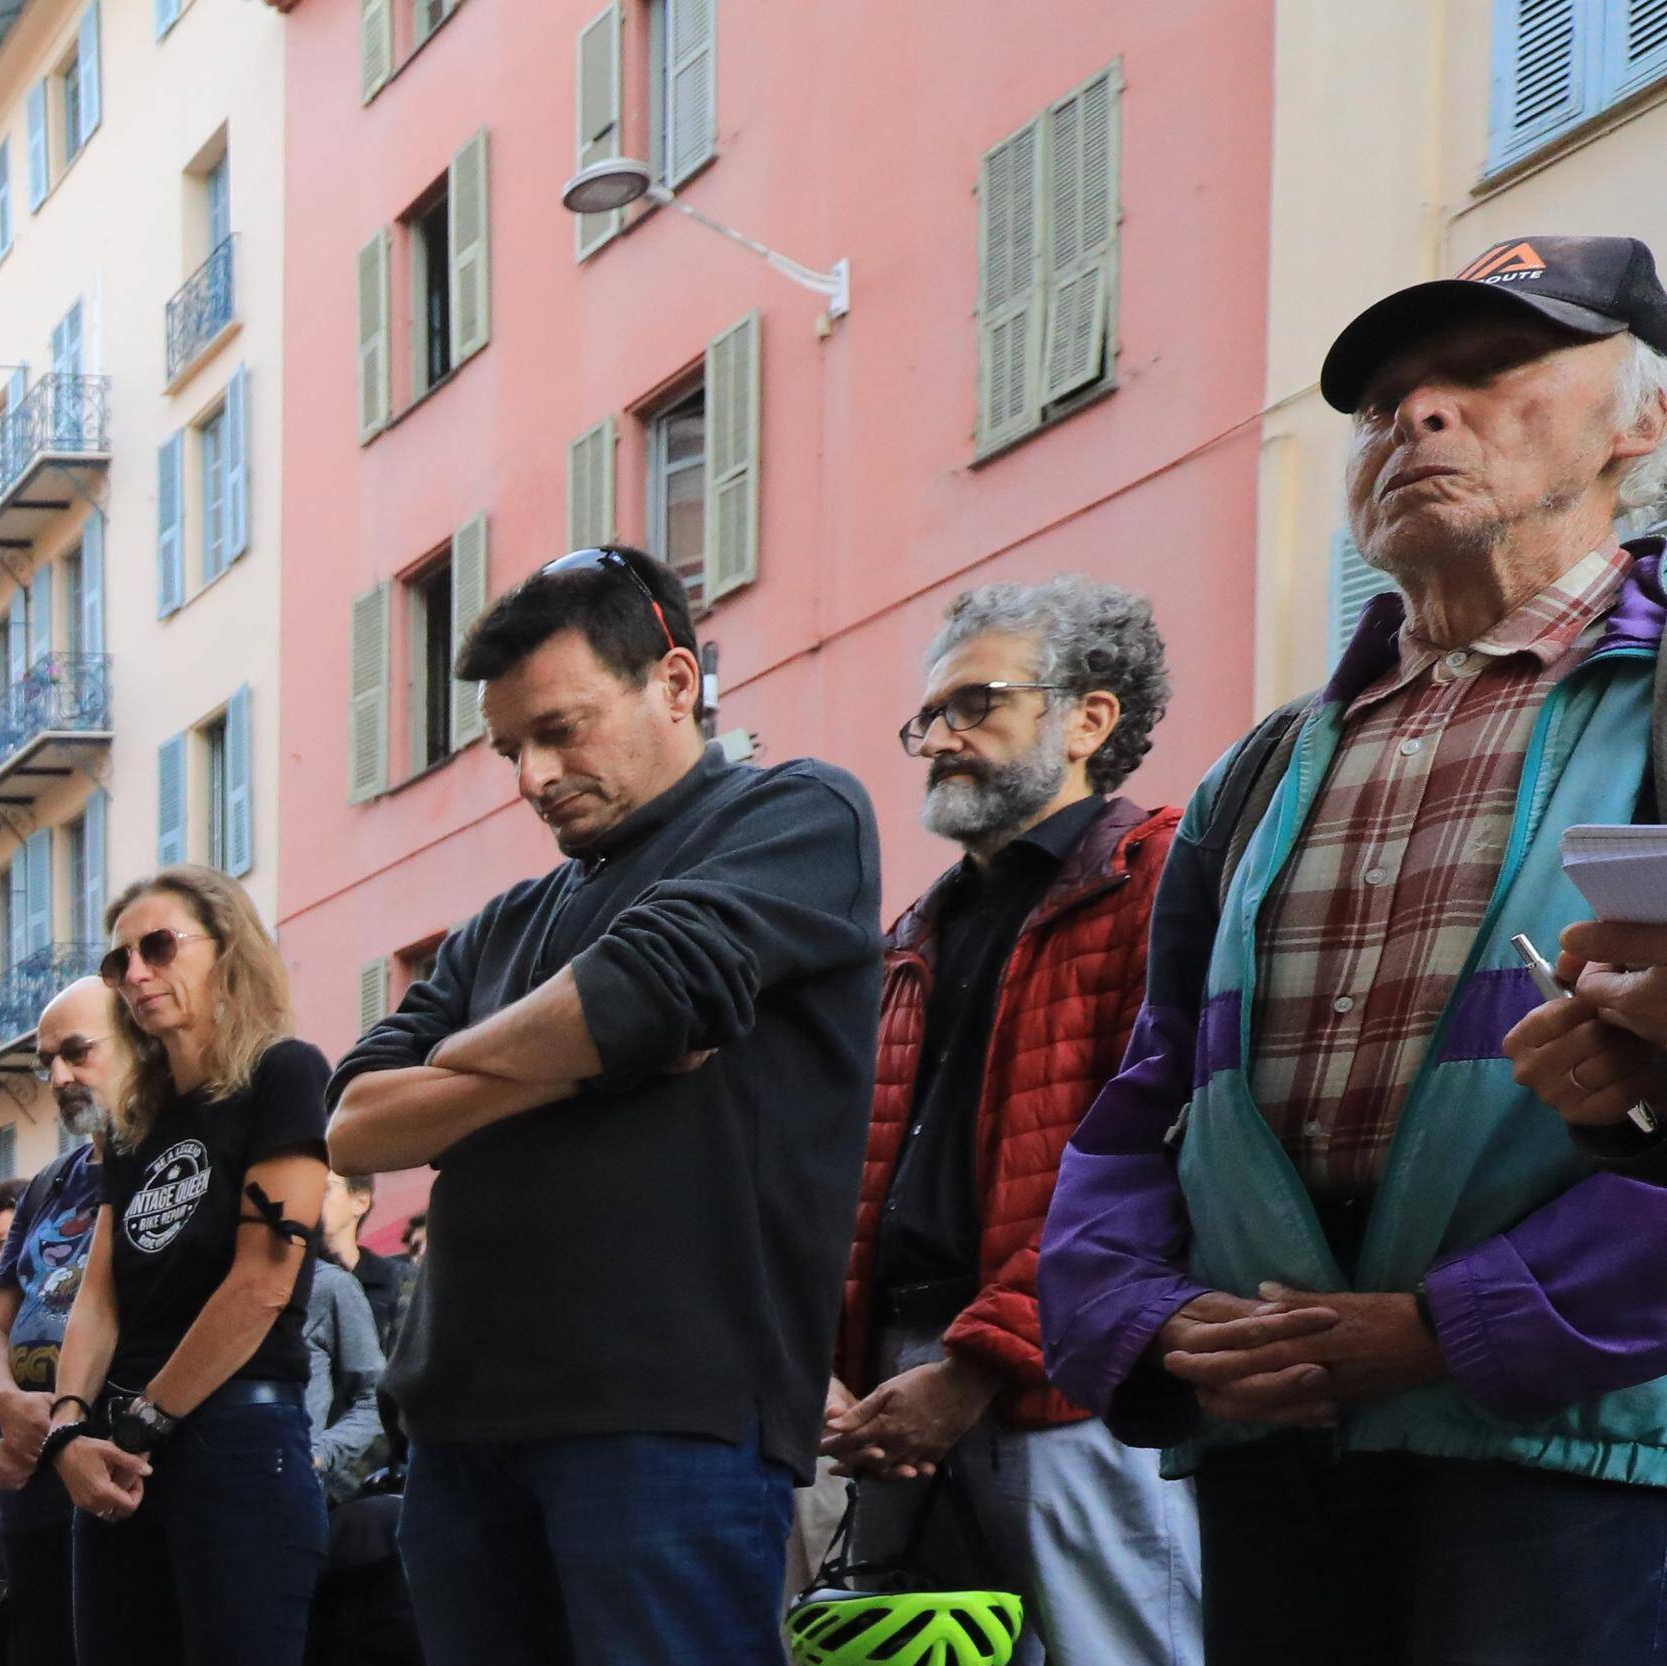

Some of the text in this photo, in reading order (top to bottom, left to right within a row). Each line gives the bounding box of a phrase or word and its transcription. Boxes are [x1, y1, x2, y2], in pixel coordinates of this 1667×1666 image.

[1475, 270, 1544, 285] OUTE
[125, 1170, 210, 1217] INTAGE QUEEN
[139, 1214, 161, 1231] BIKE
